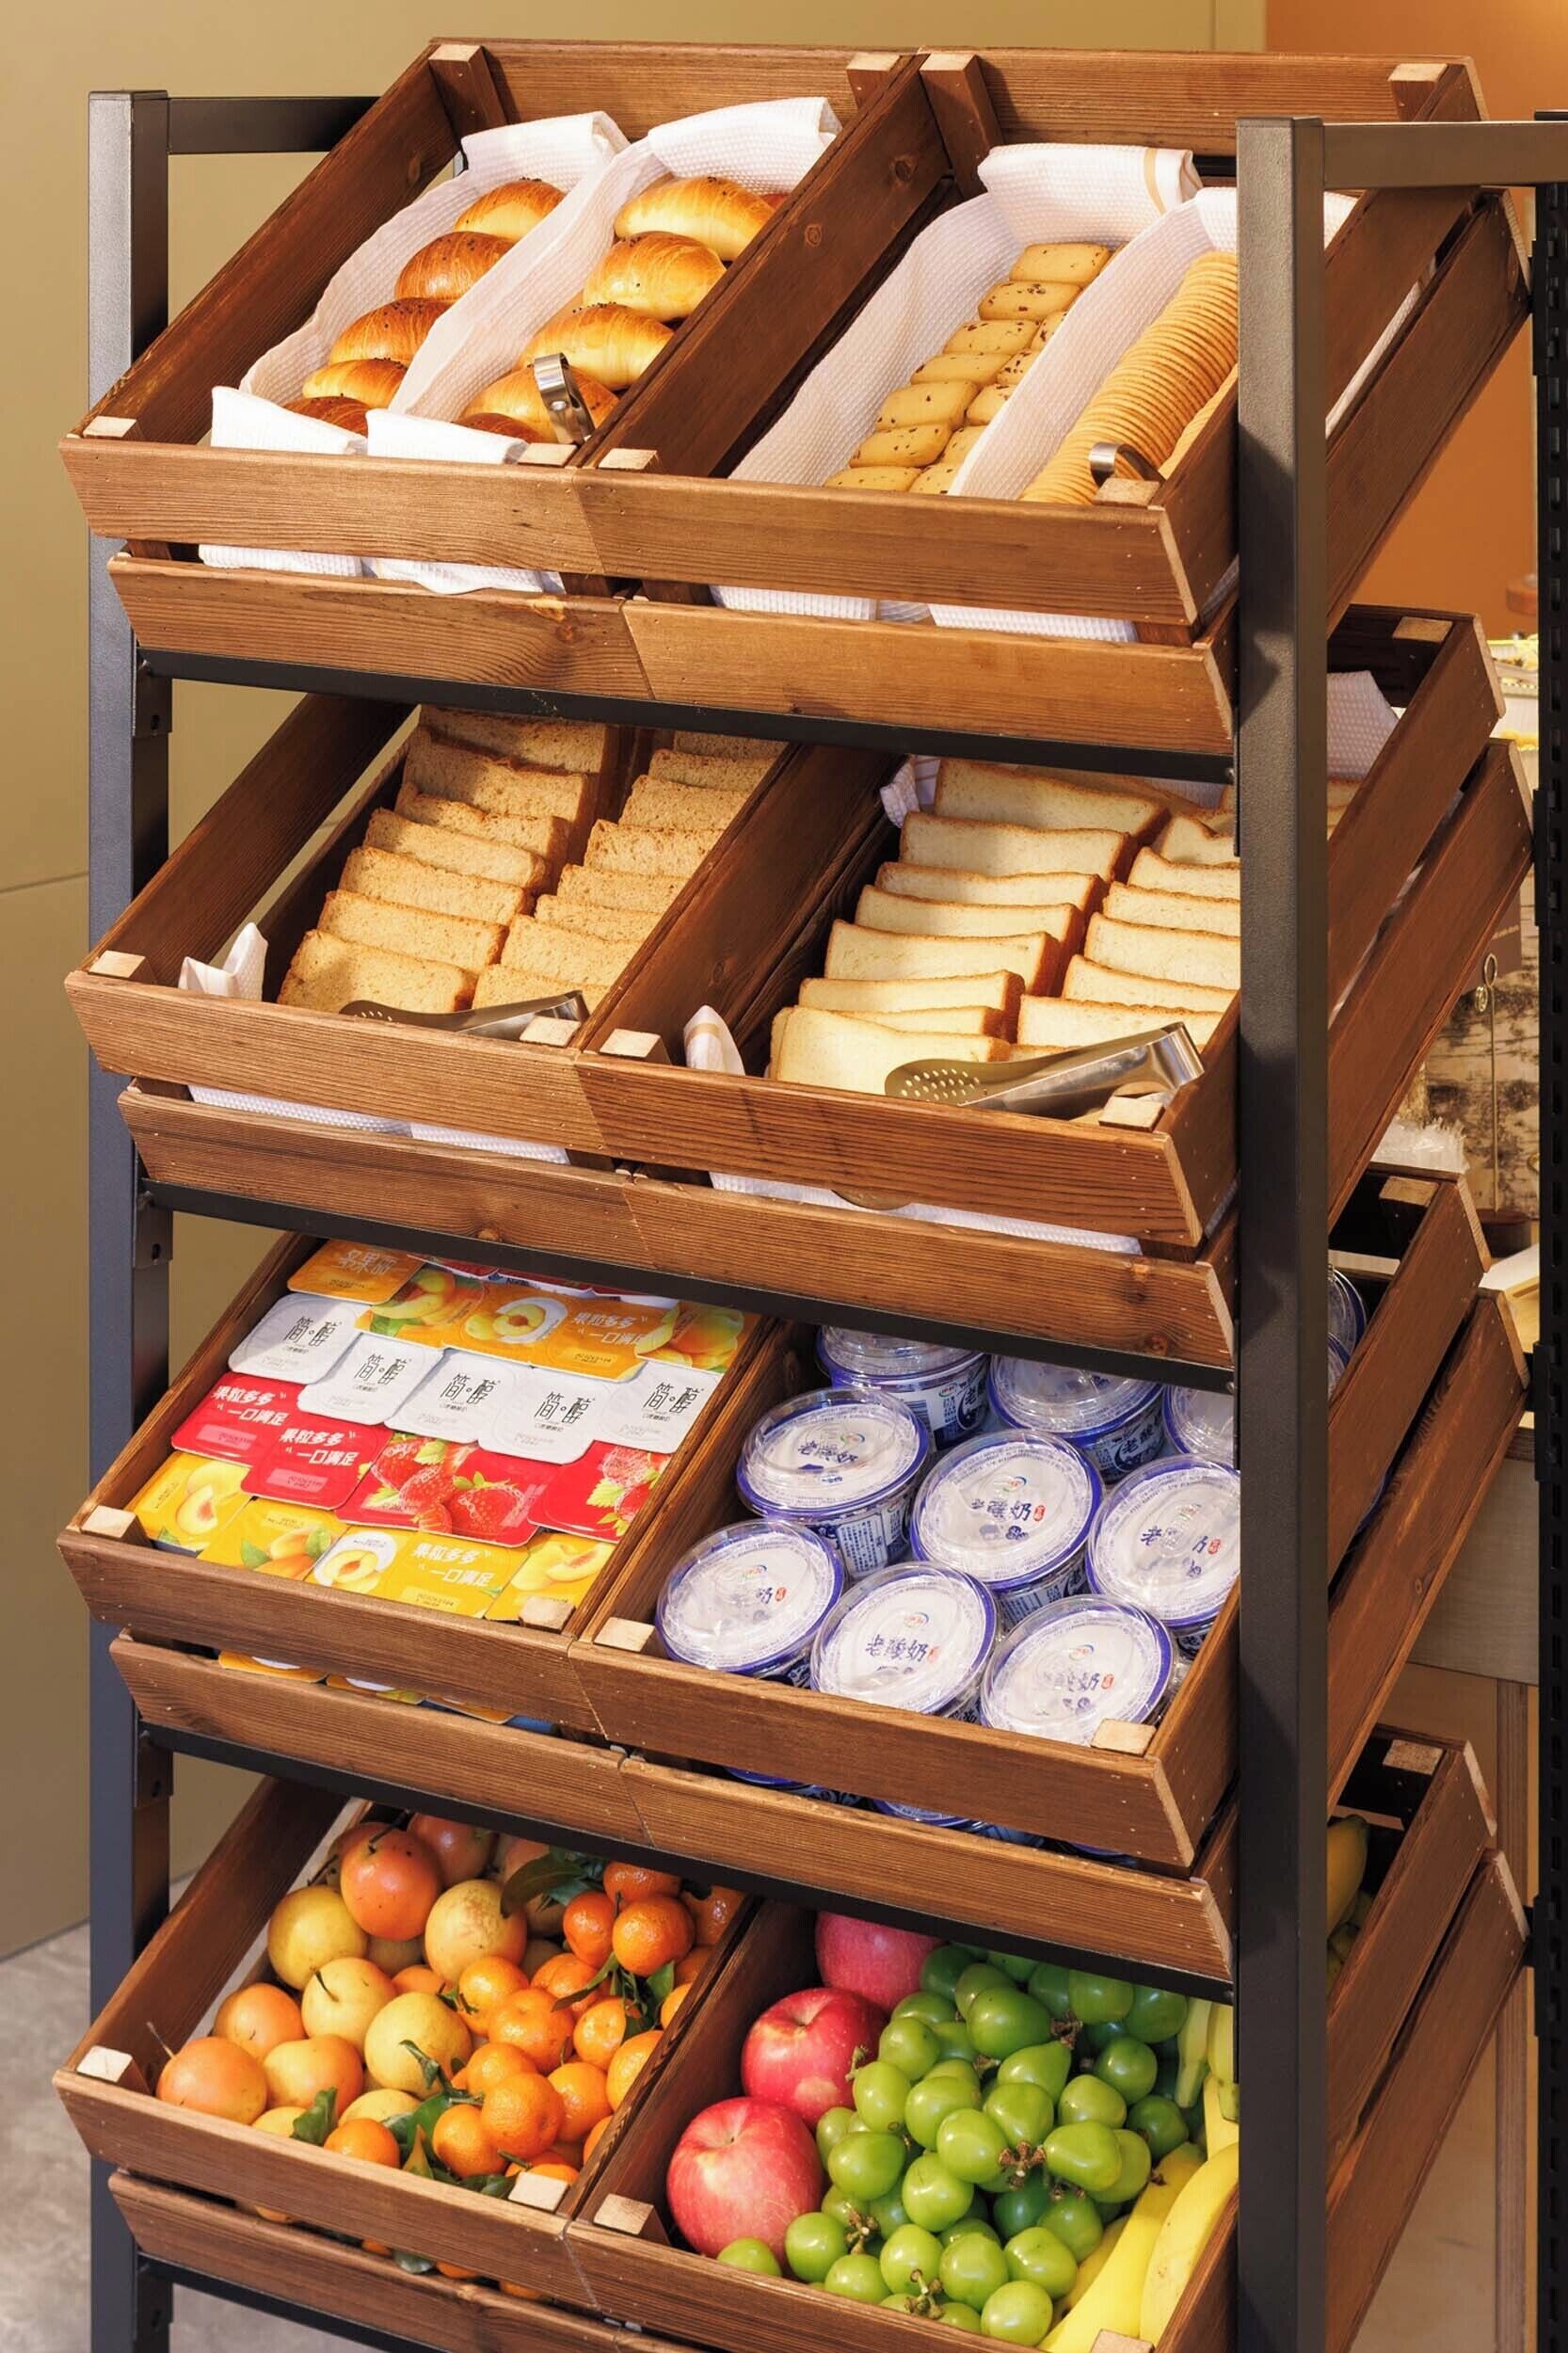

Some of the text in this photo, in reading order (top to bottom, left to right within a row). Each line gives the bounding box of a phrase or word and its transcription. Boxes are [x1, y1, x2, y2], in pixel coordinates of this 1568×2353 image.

[212, 1385, 276, 1405] 果粒多多
[227, 1408, 290, 1426] 一口满足
[280, 1428, 345, 1447] 果粒多多
[296, 1449, 360, 1467] 一口满足
[411, 1542, 481, 1565] 果粒多多
[429, 1568, 496, 1588] 一口满足
[865, 1634, 929, 1662] 老酸奶
